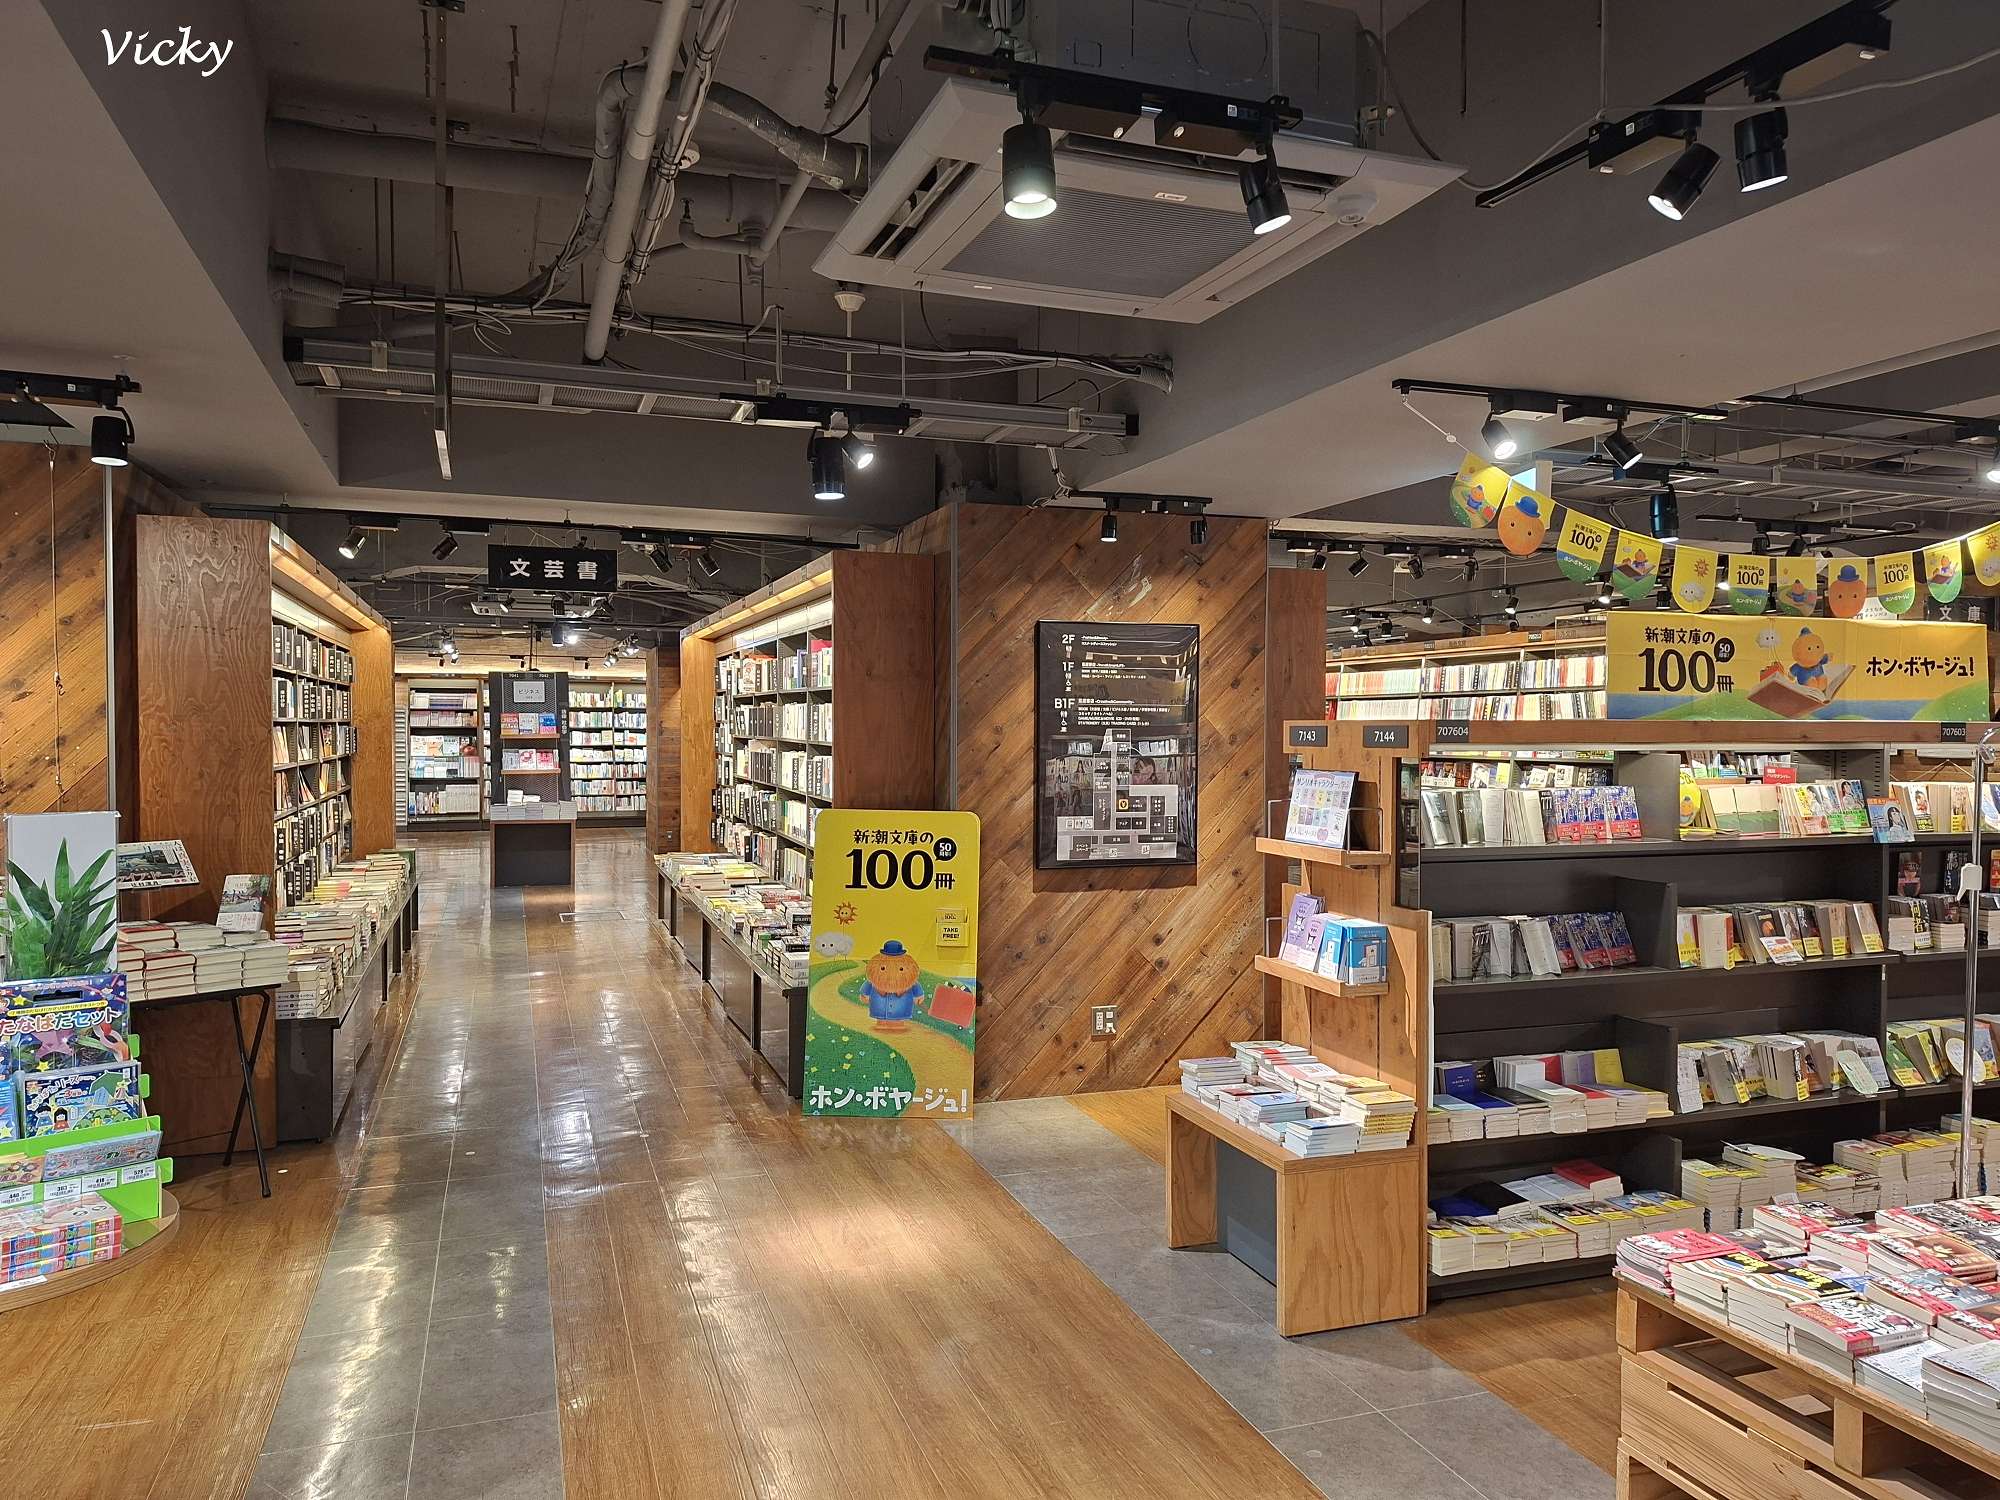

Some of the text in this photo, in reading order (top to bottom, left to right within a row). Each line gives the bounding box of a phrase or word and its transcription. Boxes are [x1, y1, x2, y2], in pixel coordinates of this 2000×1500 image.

[509, 558, 599, 581] 文芸書
[1939, 606, 1980, 621] 文庫
[1062, 634, 1075, 644] 2F
[1645, 626, 1715, 645] 新潮文庫の
[1719, 643, 1730, 653] 50
[1062, 662, 1075, 671] 1F
[1866, 656, 1974, 678] ホン・ボヤージュ!
[1054, 698, 1075, 709] B1F
[1298, 730, 1316, 741] 7143
[1374, 731, 1395, 742] 7144
[1437, 726, 1469, 736] 707604
[1942, 727, 1966, 737] 707603
[853, 829, 934, 846] 新潮文庫の
[939, 842, 952, 852] 50
[0, 1007, 121, 1036] たなばたセット
[809, 1085, 967, 1113] ホン・ボヤージュ!
